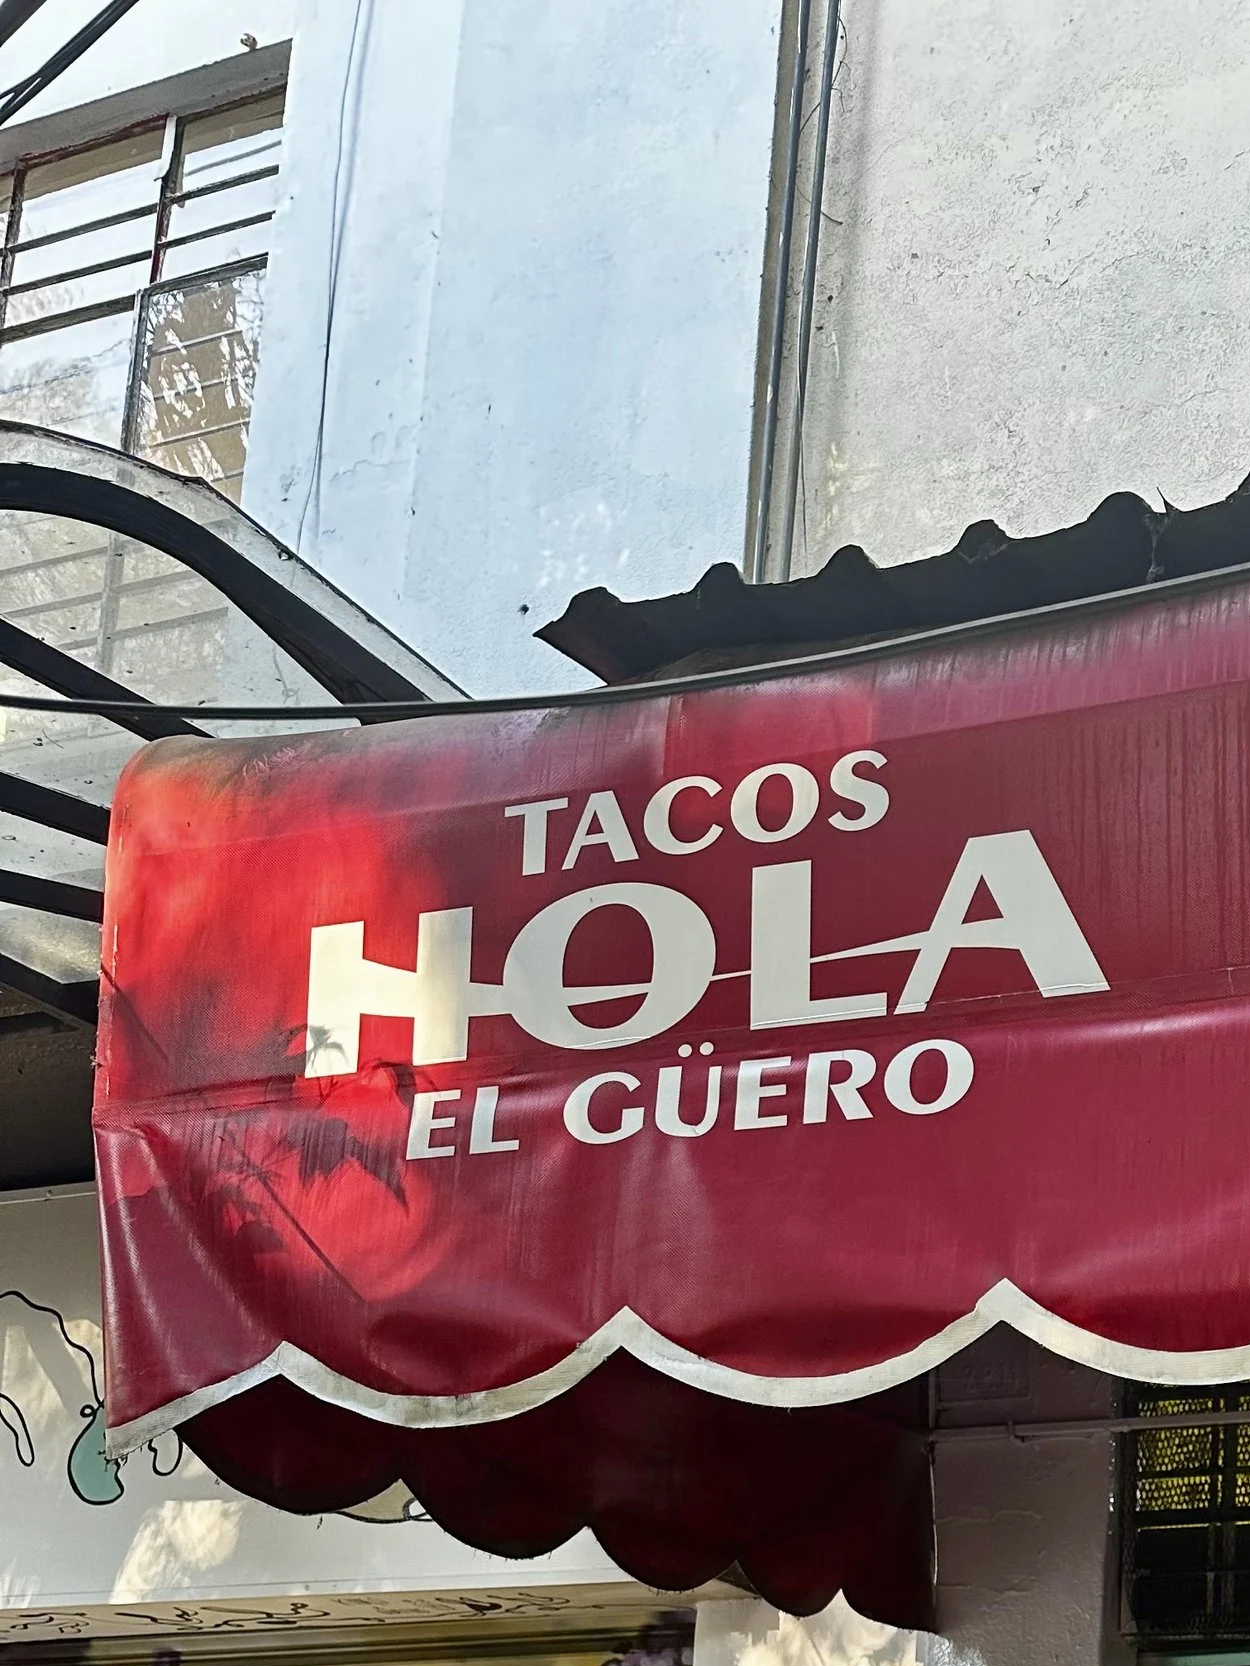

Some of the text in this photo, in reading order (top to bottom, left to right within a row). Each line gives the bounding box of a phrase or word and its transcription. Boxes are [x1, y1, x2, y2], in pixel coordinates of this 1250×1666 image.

[504, 750, 890, 876] TACOS
[304, 829, 1111, 1079] HOLA
[405, 1038, 975, 1162] EL GÜERO
